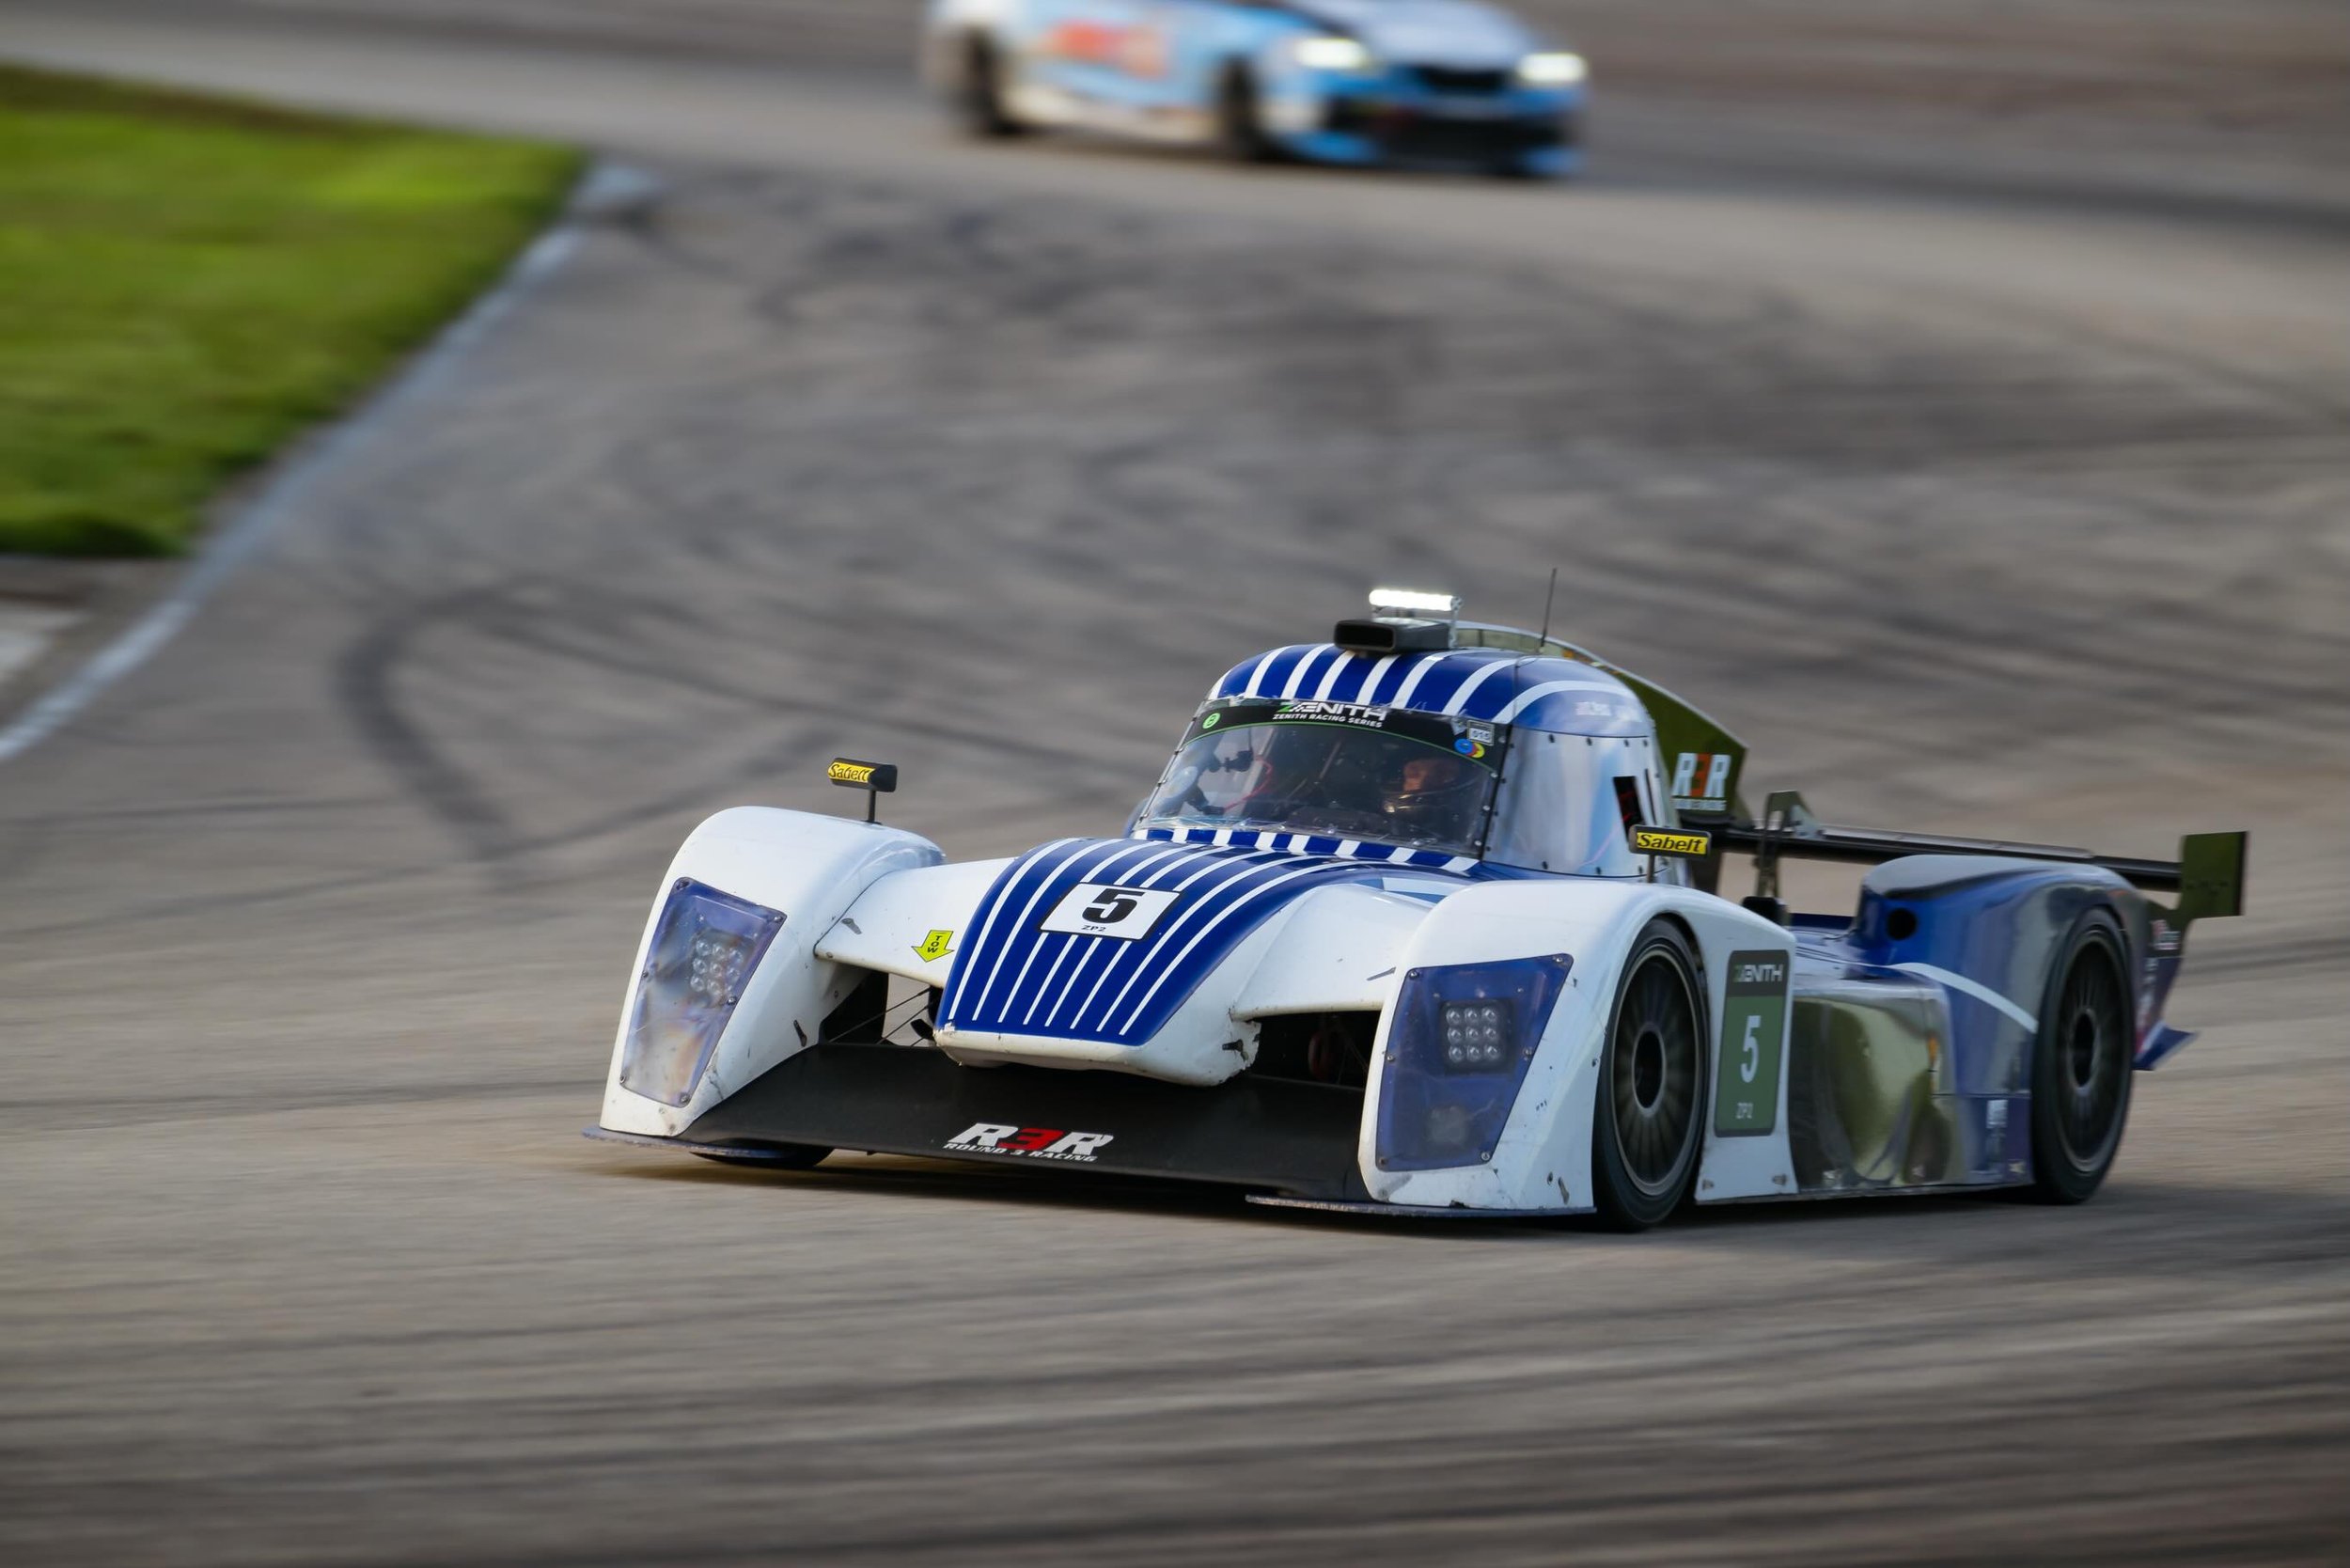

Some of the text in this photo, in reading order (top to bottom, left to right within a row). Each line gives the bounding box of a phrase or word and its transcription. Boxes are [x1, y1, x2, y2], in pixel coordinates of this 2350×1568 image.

[1277, 701, 1387, 721] ZENITH
[1308, 713, 1345, 722] RACING
[1348, 717, 1382, 728] SERIES
[1672, 752, 1731, 797] R3R
[1638, 834, 1701, 852] Sabelt
[1082, 888, 1146, 923] 5
[1081, 924, 1106, 933] ZP2
[927, 934, 943, 953] TOW
[1734, 964, 1783, 982] ZENITH
[1741, 1014, 1761, 1083] 5
[948, 1122, 1114, 1155] R3R
[942, 1142, 1099, 1163] ROUND 3 RACING
